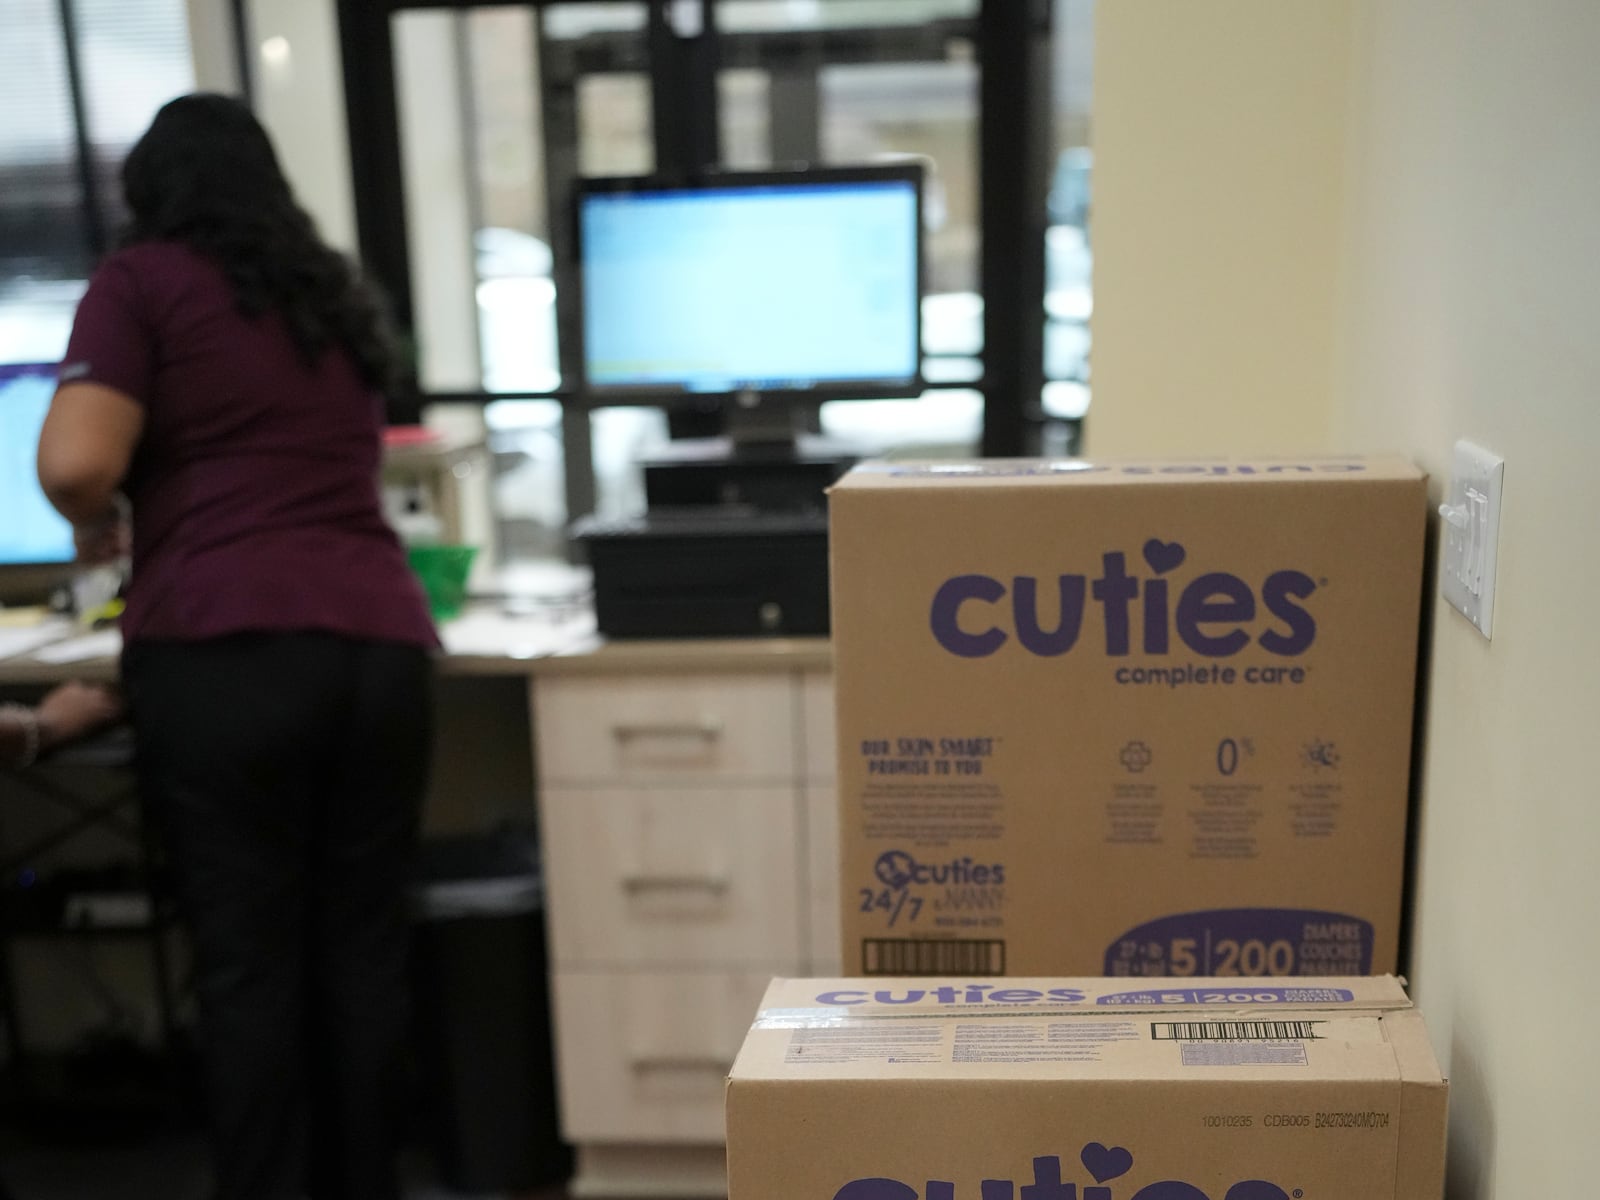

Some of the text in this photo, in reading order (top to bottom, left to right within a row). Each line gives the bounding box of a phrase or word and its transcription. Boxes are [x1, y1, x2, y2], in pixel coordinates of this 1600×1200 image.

[930, 538, 1317, 658] cuties
[1115, 664, 1305, 687] complete care
[914, 856, 1005, 884] cuties
[860, 888, 924, 927] 24/7
[1170, 939, 1197, 976] 5
[1215, 939, 1294, 976] 200
[816, 985, 1086, 1005] cuties
[1160, 994, 1185, 1003] 5
[1203, 993, 1278, 1003] 200
[1203, 1116, 1252, 1127] 10010235
